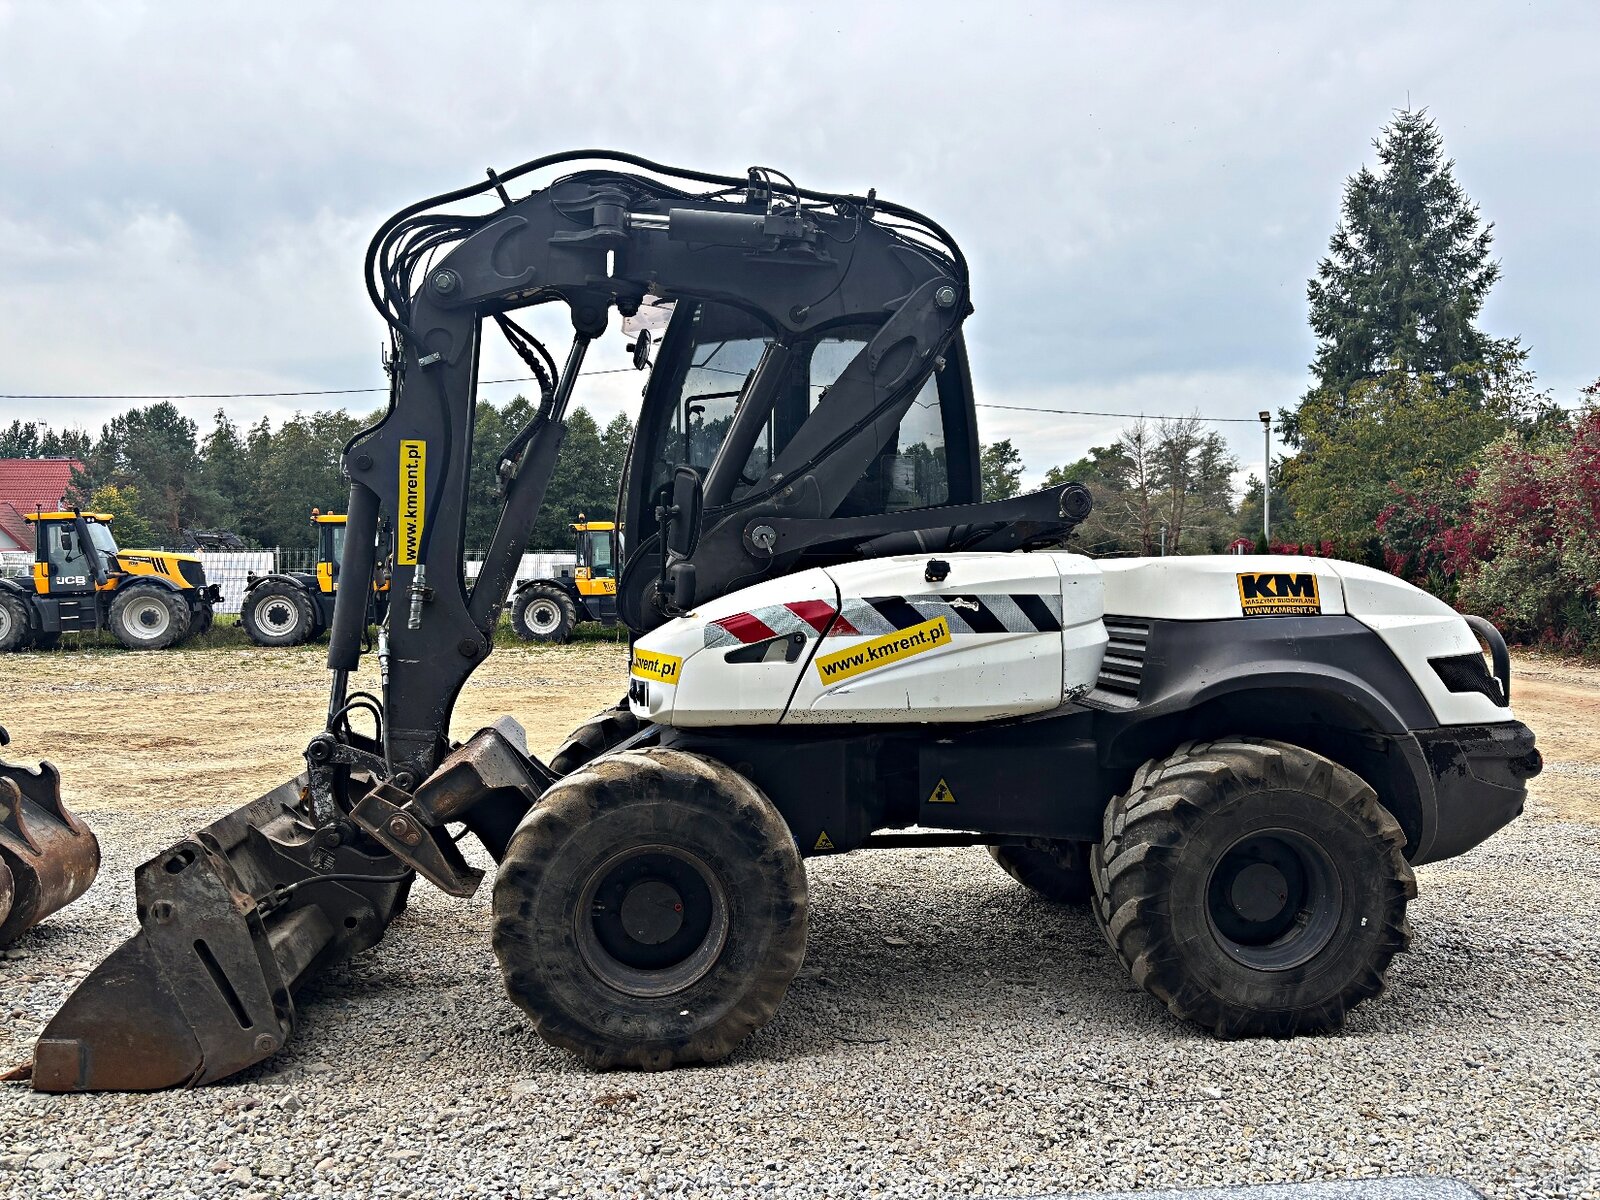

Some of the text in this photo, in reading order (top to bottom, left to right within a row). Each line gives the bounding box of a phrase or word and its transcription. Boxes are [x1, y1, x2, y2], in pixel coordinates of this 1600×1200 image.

[404, 445, 421, 561] www.kmrent.pl
[56, 576, 86, 585] JCB
[1241, 574, 1315, 598] KM
[1245, 607, 1319, 615] WWW.KMRENT.PL
[822, 623, 945, 676] www.kmrent.pl
